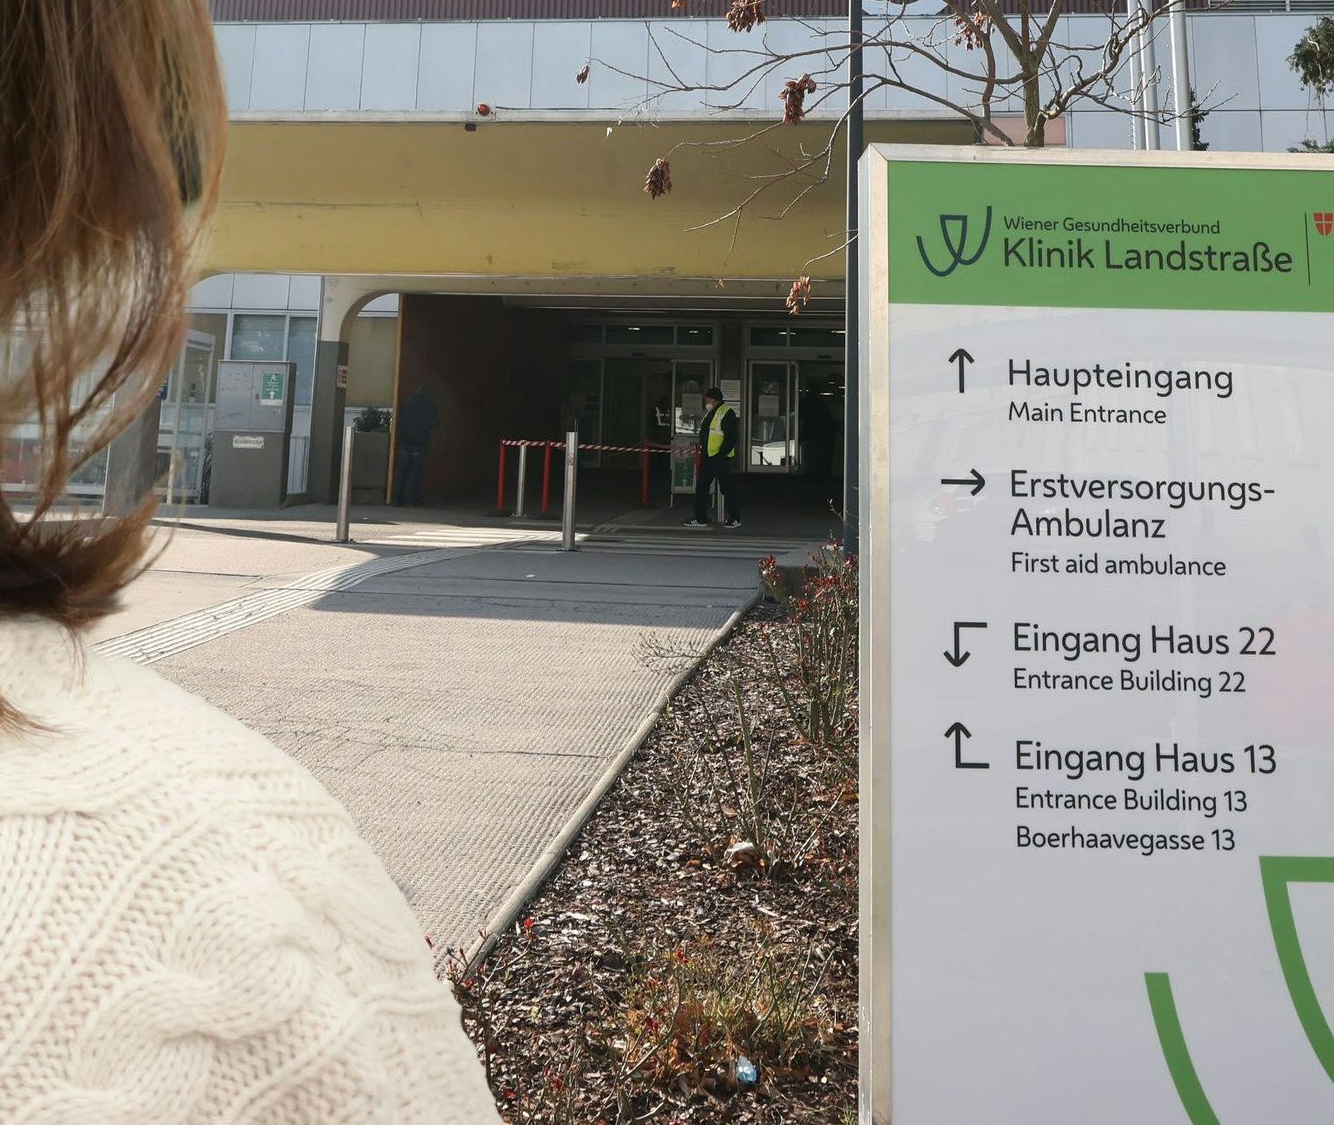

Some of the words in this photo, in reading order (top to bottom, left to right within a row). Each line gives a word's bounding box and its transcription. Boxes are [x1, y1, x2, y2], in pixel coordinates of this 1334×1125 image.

[1004, 216, 1059, 230] Wiener
[1063, 217, 1220, 234] Gesundheitsverbund
[1004, 237, 1094, 268] Klinik
[1105, 240, 1292, 272] Landstraße
[1009, 359, 1232, 398] Haupteingang
[1009, 402, 1062, 421] Main
[1071, 403, 1166, 424] Entrance
[1011, 470, 1274, 510] Erstversorgungs-
[1011, 508, 1165, 538] Ambulanz
[1012, 552, 1059, 572] First
[1066, 553, 1098, 573] aid
[1105, 554, 1226, 576] ambulance
[1014, 623, 1140, 662] Eingang
[1152, 625, 1229, 654] Haus
[1239, 627, 1276, 655] 22
[1014, 668, 1113, 690] Entrance
[1121, 670, 1211, 698] Building
[1219, 672, 1245, 692] 22
[1017, 741, 1144, 781] Eingang
[1156, 743, 1234, 773] Haus
[1244, 745, 1276, 774] 13
[1017, 787, 1116, 809] Entrance
[1125, 789, 1216, 818] Building
[1224, 791, 1247, 812] 13
[1017, 826, 1204, 856] Boerhaavegasse
[1212, 829, 1235, 850] 13
